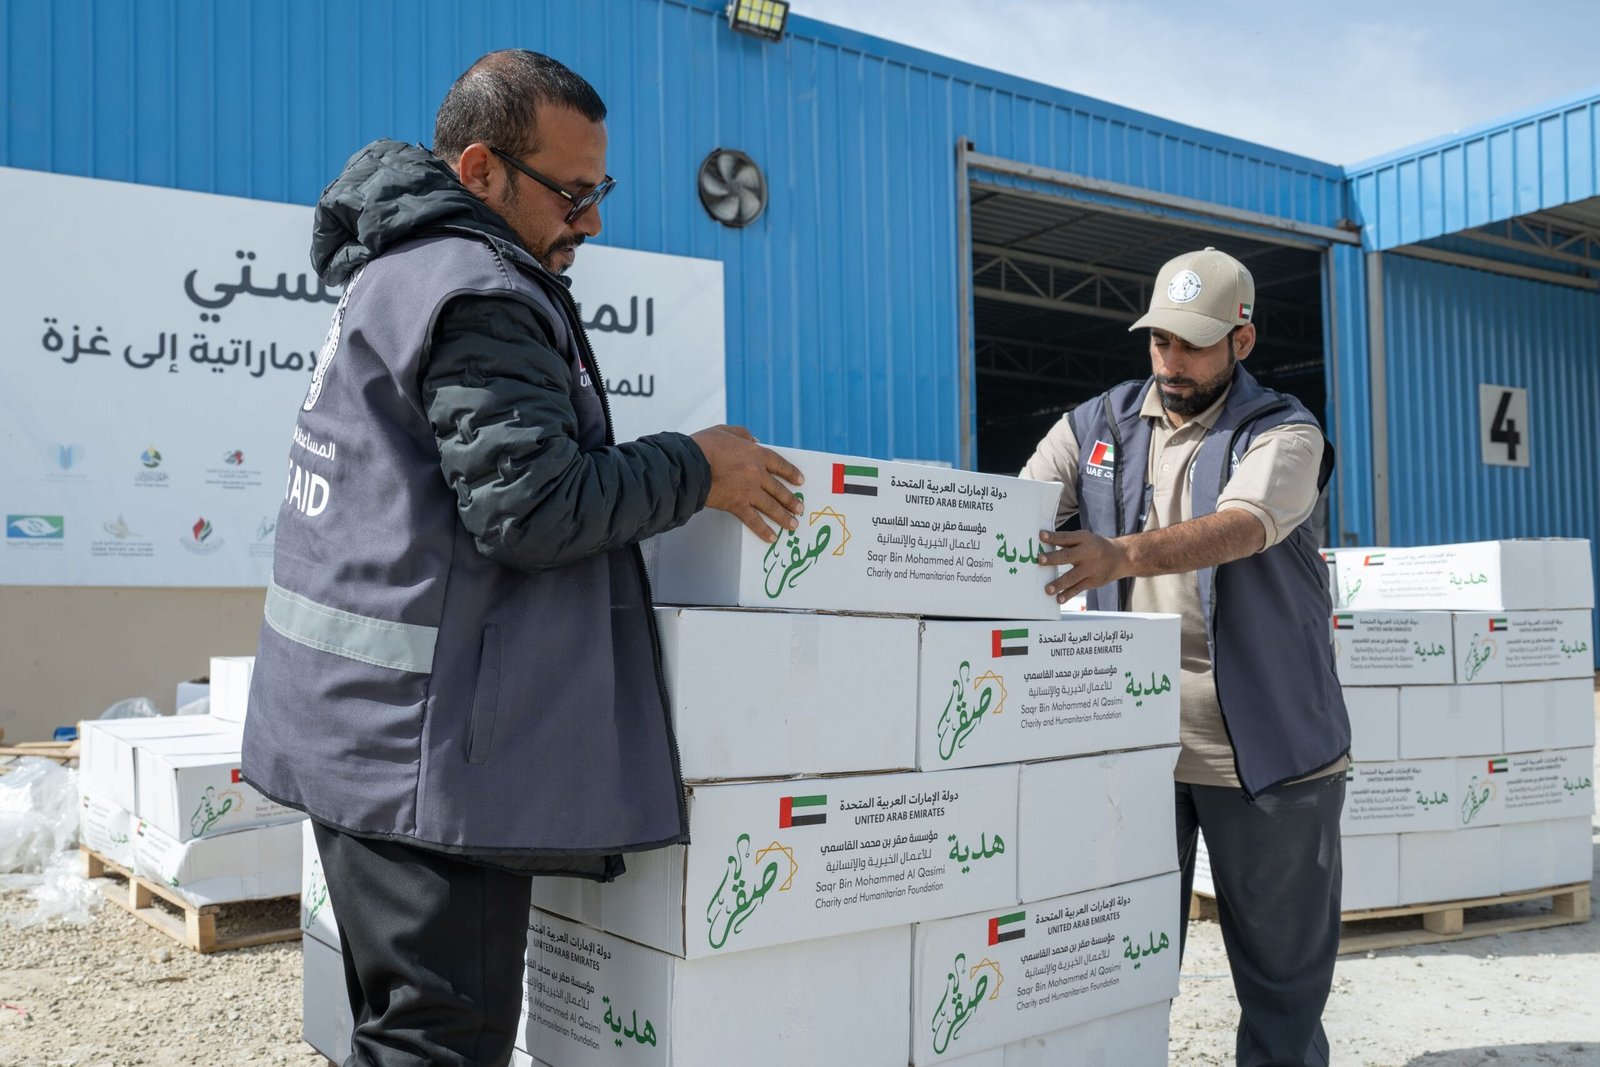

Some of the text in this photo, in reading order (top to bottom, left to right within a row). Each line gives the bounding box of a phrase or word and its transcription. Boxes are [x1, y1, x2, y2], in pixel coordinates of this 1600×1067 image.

[42, 317, 110, 363] غزة
[123, 332, 178, 373] إلى
[1490, 391, 1520, 461] 4
[891, 476, 1007, 500] دولة الإمارات العربية المتحدة
[906, 494, 993, 511] UNITED ARAB EMIRATES
[872, 516, 986, 535] مؤسسة صقر بن محمد القاسمي
[877, 533, 980, 551] للأعمال الخيرية والإنسانية
[868, 550, 993, 568] Saqr Bin Mohammed Al Qasimi
[867, 567, 991, 583] Charity and Humanitarian Foundation
[1039, 630, 1133, 644] دولة الإمارات العربية المتحدة
[1051, 645, 1122, 657] UNITED ARAB EMIRATES
[1414, 641, 1446, 661] هدية
[1560, 639, 1587, 658] هدية
[1024, 670, 1053, 682] القاسمي
[1072, 670, 1080, 679] بن
[1081, 668, 1093, 679] صقر
[1094, 665, 1117, 676] مؤسسة
[1125, 671, 1171, 707] هدية
[1021, 696, 1123, 715] Saqr Bin Mohammed Al Qasimi
[1021, 710, 1122, 728] Charity and Humanitarian Foundation
[1563, 777, 1592, 795] هدية
[840, 790, 958, 810] دولة الإمارات العربية المتحدة
[1416, 791, 1448, 810] هدية
[855, 807, 944, 825] UNITED ARAB EMIRATES
[820, 830, 938, 855] مؤسسة صقر بن محمد القاسمي
[826, 848, 931, 873] للأعمال الخيرية والإنسانية
[947, 832, 1005, 874] هدية
[816, 865, 945, 893] Saqr Bin Mohammed Al Qasimi
[815, 881, 943, 908] Charity and Humanitarian Foundation
[1036, 897, 1130, 924] دولة الإمارات العربية المتحدة
[1048, 912, 1120, 935] UNITED ARAB EMIRATES
[1021, 933, 1114, 964] مؤسسة صقر بن محمد القاسمي
[1123, 931, 1169, 970] هدية
[1017, 964, 1121, 996] Saqr Bin Mohammed Al Qasimi
[1017, 978, 1119, 1010] Charity and Humanitarian Foundation
[602, 996, 656, 1047] هدية
